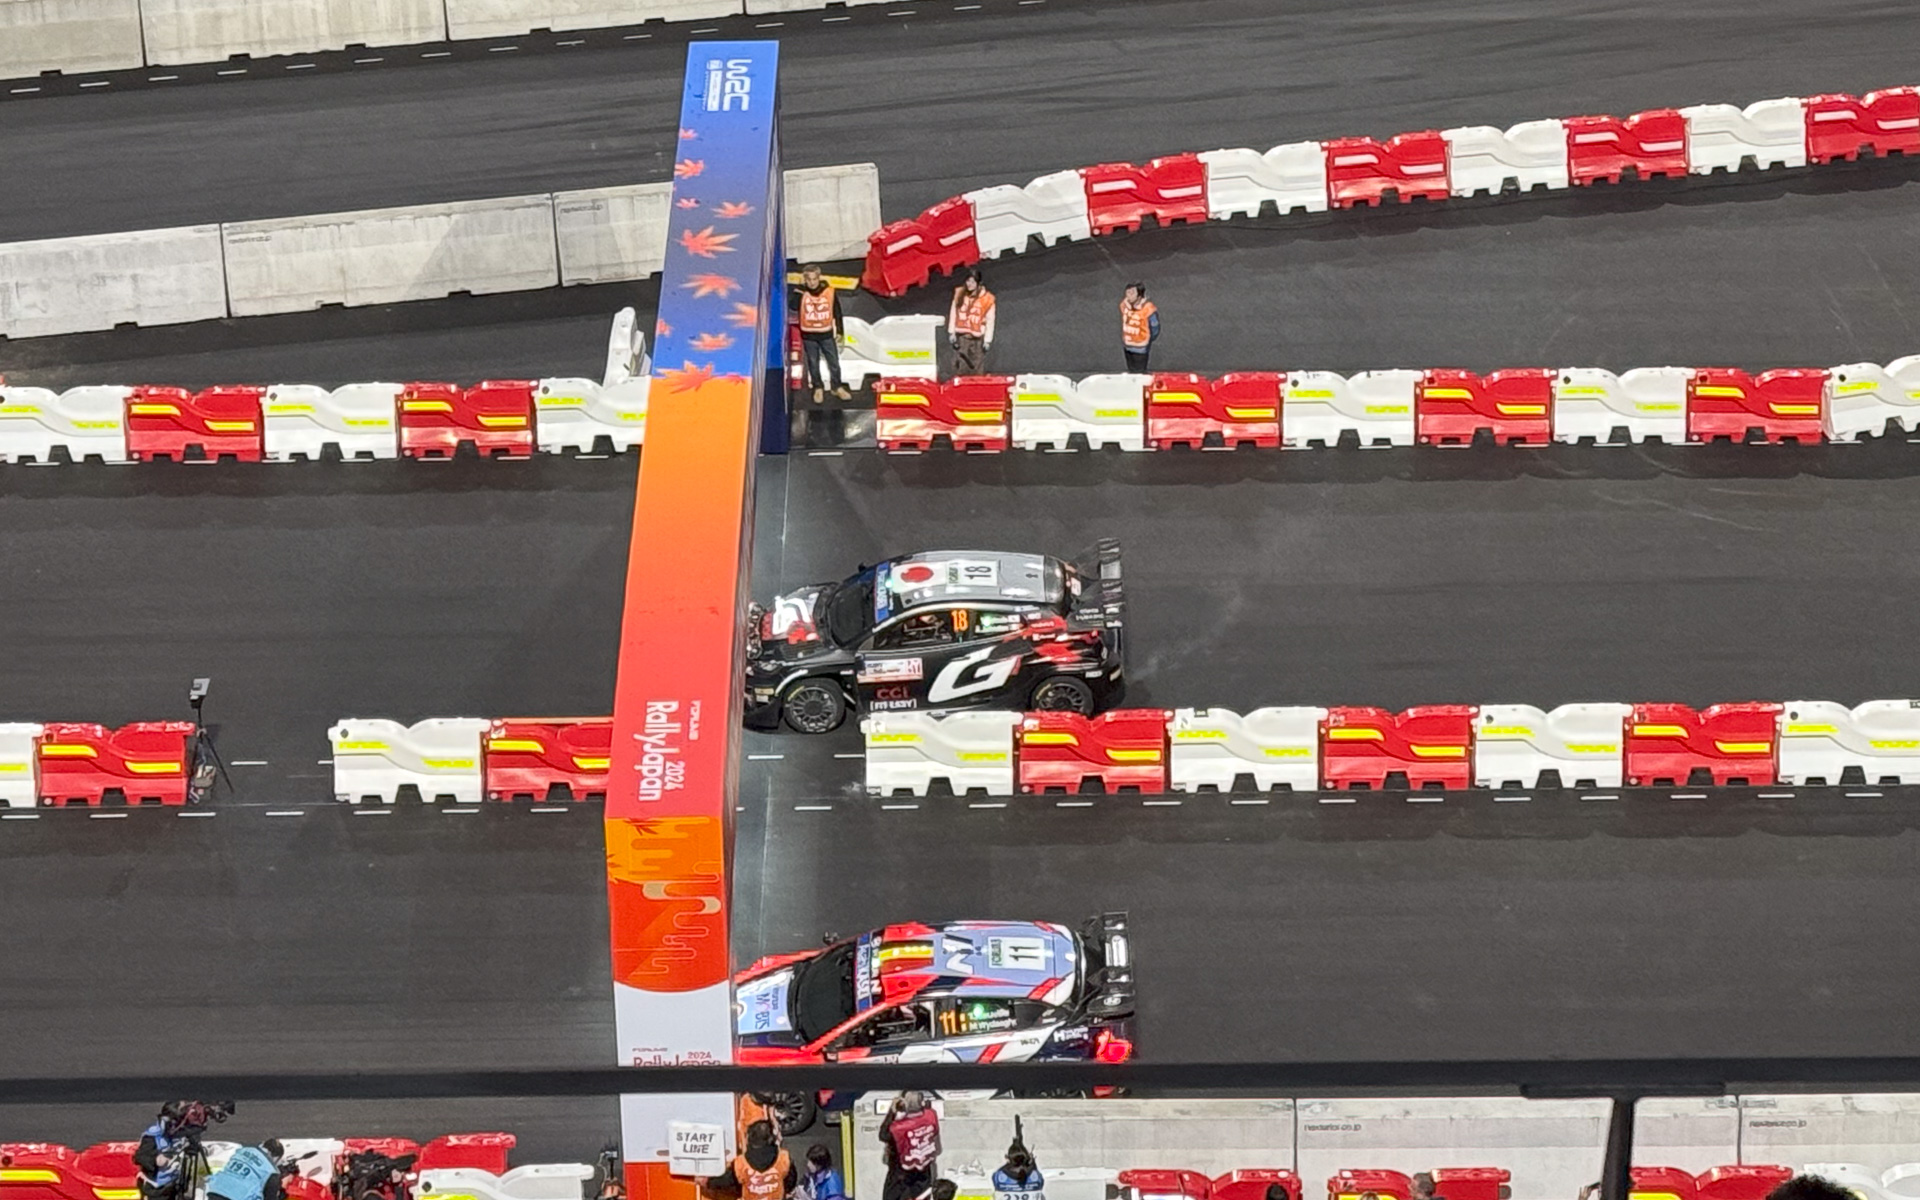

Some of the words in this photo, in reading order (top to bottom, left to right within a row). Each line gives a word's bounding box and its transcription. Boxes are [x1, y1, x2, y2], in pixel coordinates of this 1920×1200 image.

[722, 58, 752, 112] WRC
[963, 565, 992, 580] 18
[951, 609, 969, 633] 18
[663, 760, 686, 791] 2024
[1008, 945, 1040, 961] 11
[938, 1008, 957, 1036] 11
[687, 1051, 712, 1059] 2024
[676, 1131, 715, 1143] START
[682, 1143, 710, 1154] LINE
